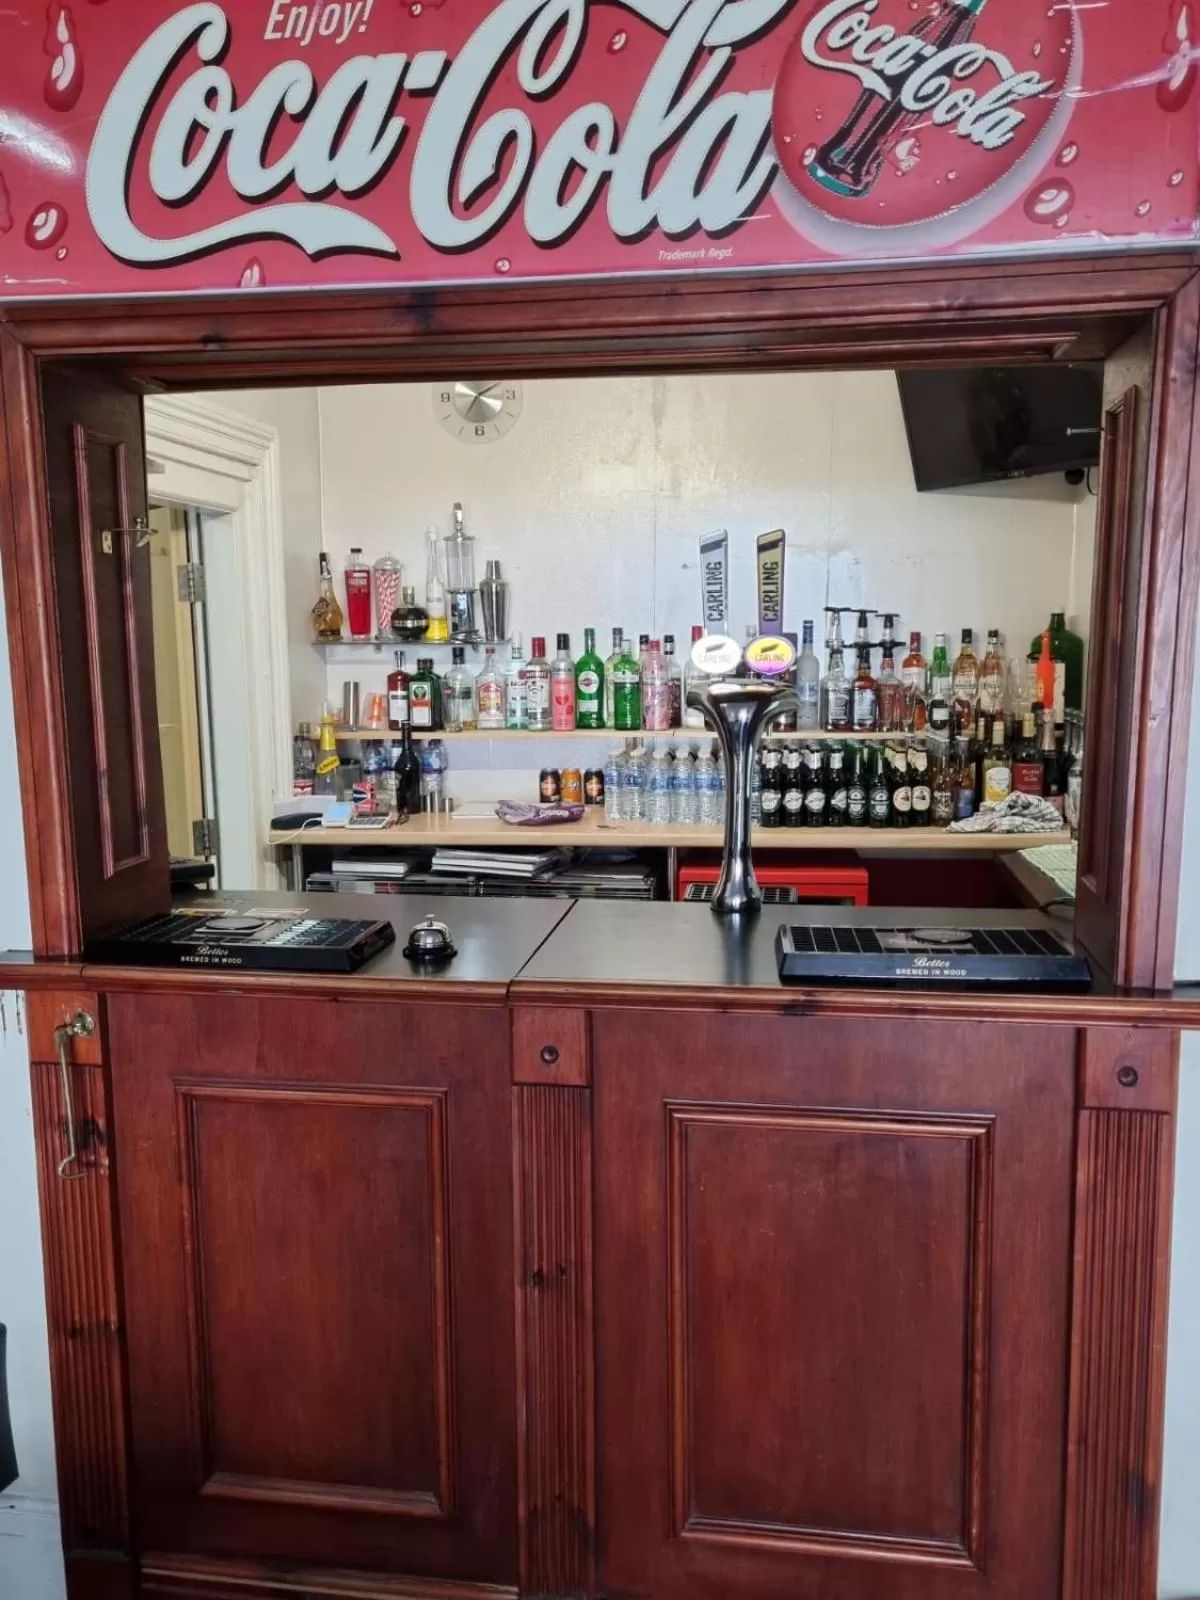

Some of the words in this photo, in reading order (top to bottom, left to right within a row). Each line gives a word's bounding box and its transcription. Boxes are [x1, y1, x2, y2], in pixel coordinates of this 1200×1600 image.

[263, 0, 374, 46] Enjoy!
[801, 0, 1054, 150] Coca-Cola
[86, 0, 777, 262] Coca-Cola
[657, 247, 706, 261] Trademark
[705, 560, 724, 622] CARLING
[762, 560, 779, 622] CARLING
[180, 955, 209, 963] BREWED
[221, 956, 242, 964] WOOD
[895, 967, 929, 976] BREWED
[931, 968, 941, 976] IN
[943, 968, 967, 977] WOOD
